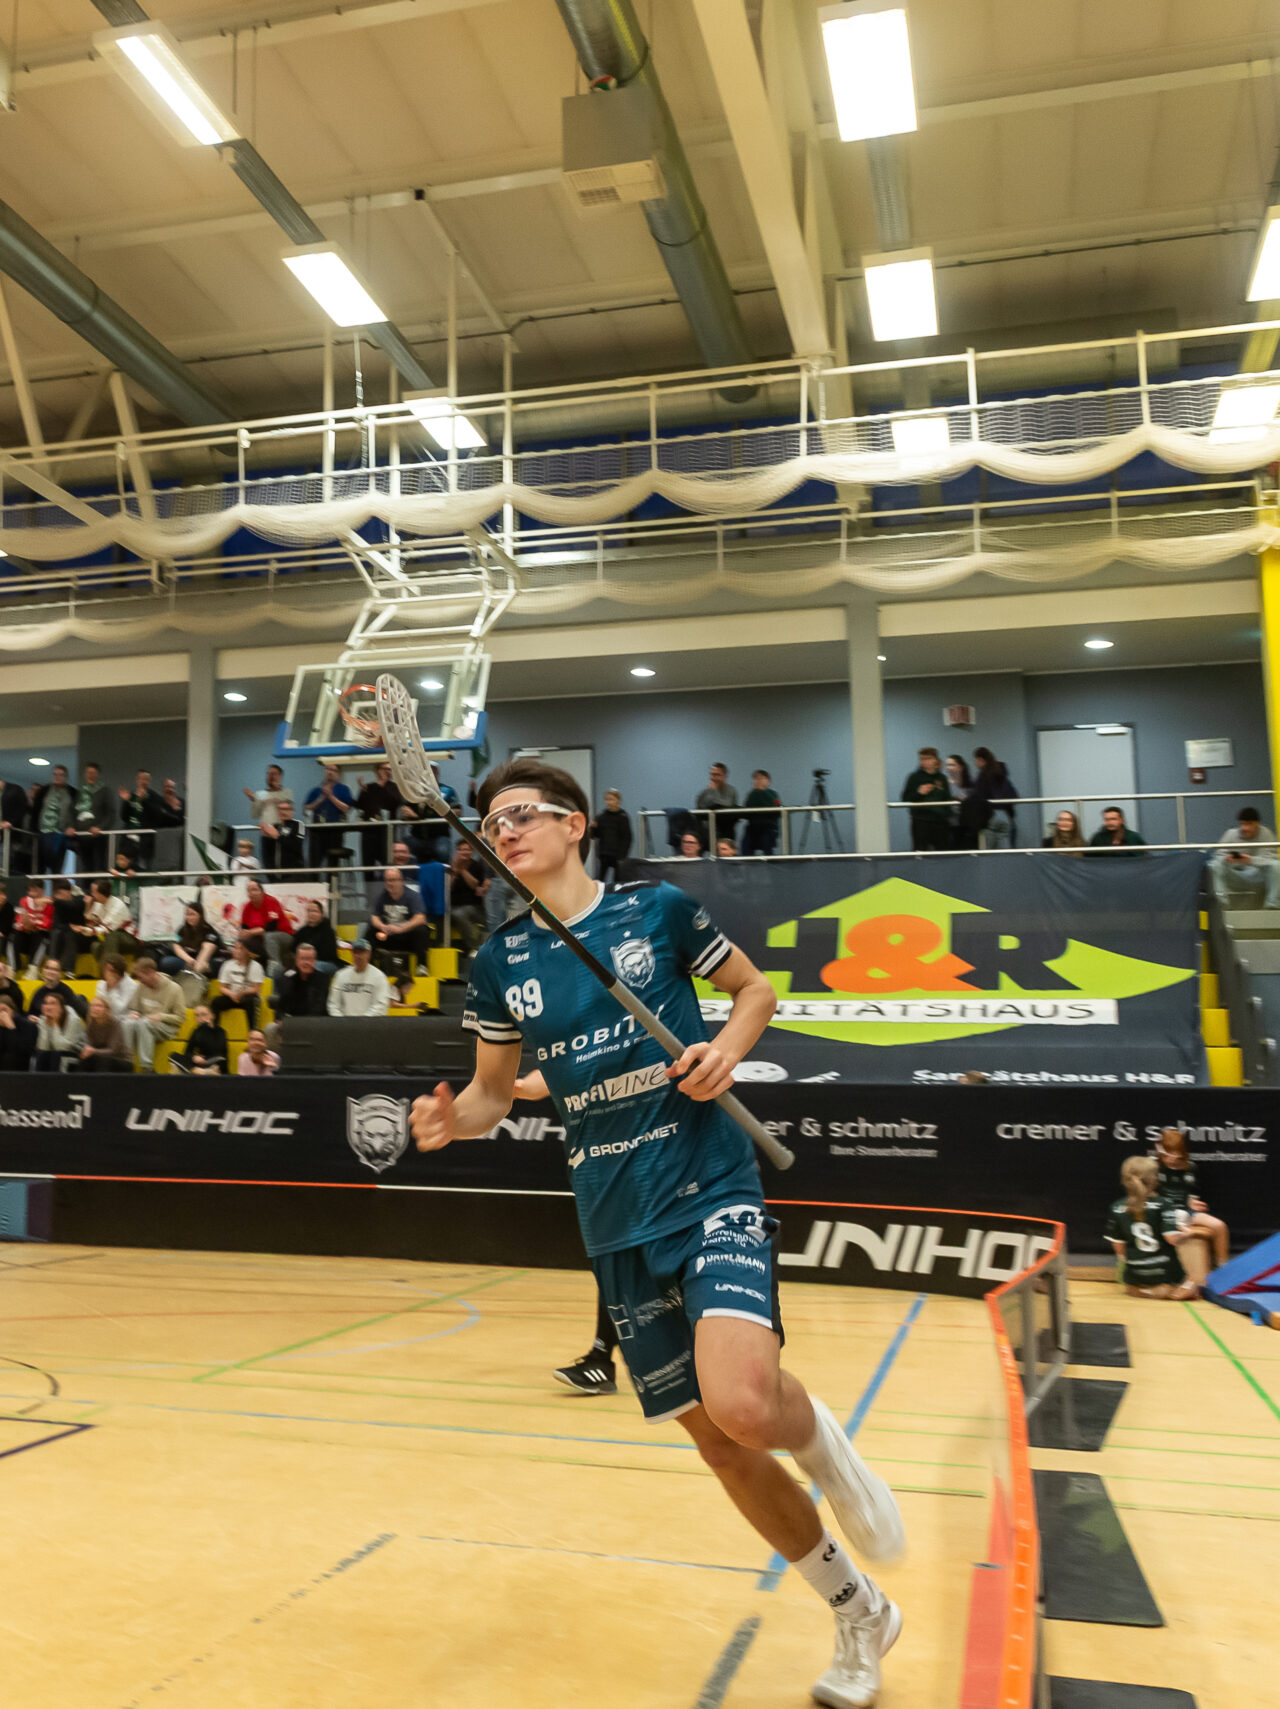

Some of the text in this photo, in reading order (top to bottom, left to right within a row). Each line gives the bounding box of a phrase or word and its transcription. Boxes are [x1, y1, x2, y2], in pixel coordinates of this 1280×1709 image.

[714, 914, 1082, 993] H&R
[505, 978, 544, 1022] 89
[700, 1002, 1096, 1020] SITÄTSHAUS
[576, 1043, 621, 1064] Heimkino
[912, 1069, 1196, 1085] Sanätshaus H&R
[125, 1107, 301, 1136] UNIHOC
[800, 1117, 823, 1137] &
[828, 1116, 940, 1139] schmitz
[996, 1122, 1107, 1140] cremer
[1113, 1120, 1139, 1141] &
[589, 1121, 679, 1158] GRONOMET
